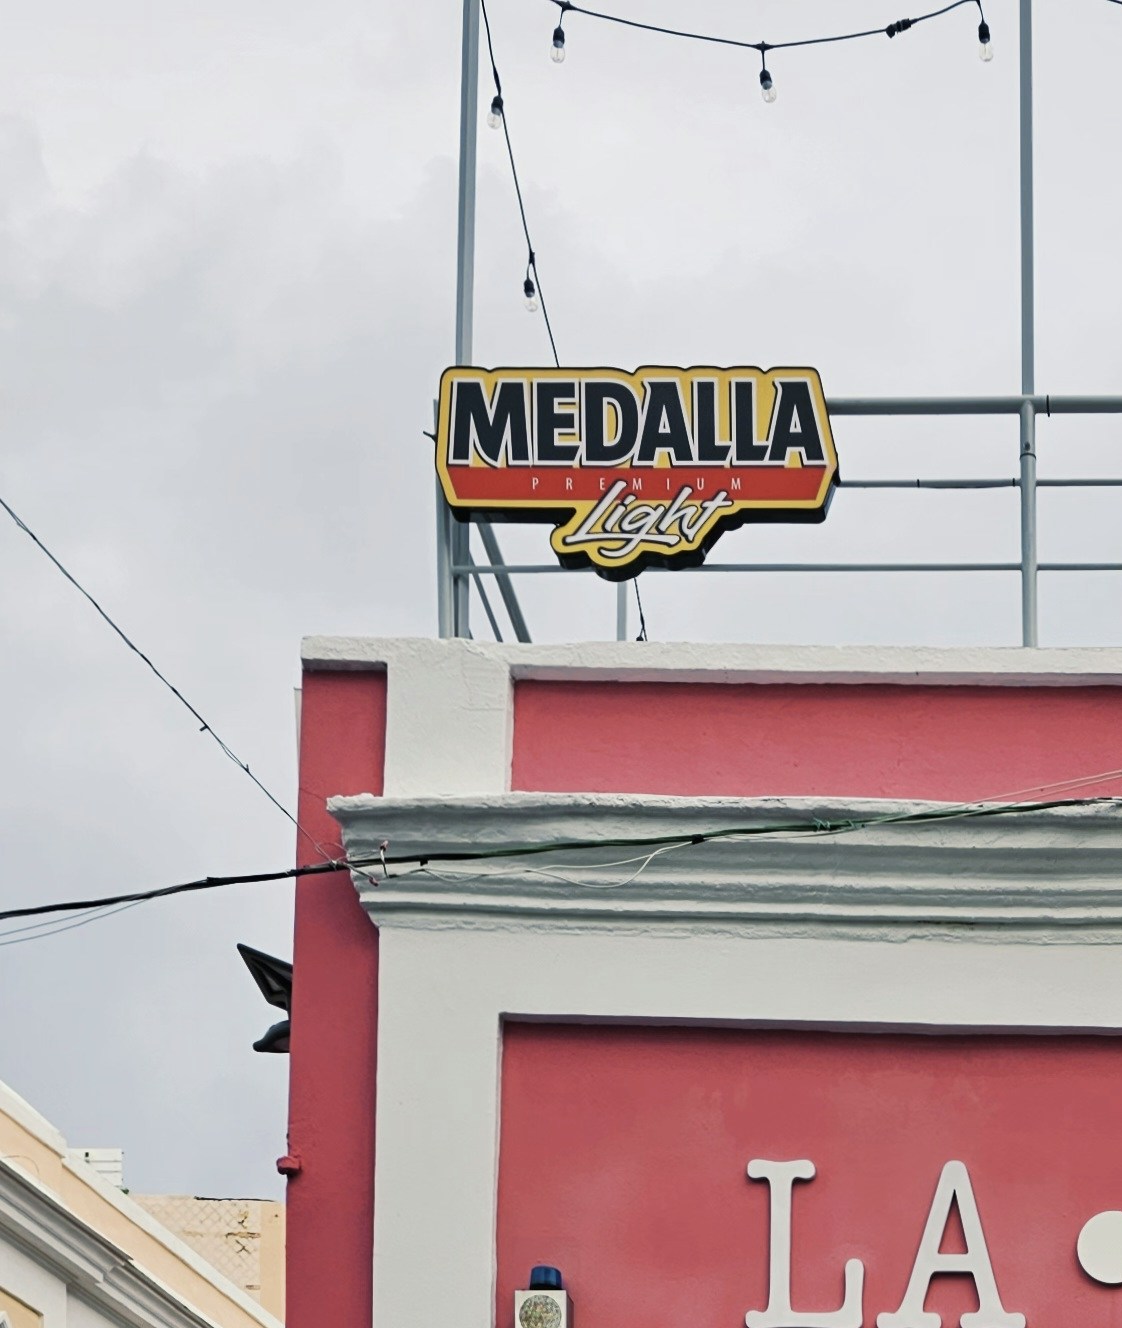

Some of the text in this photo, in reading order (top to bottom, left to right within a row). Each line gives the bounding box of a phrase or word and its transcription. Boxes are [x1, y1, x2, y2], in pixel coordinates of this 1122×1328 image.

[447, 376, 830, 468] MEDALLA
[532, 477, 742, 491] PREMIUM
[563, 480, 734, 558] Light
